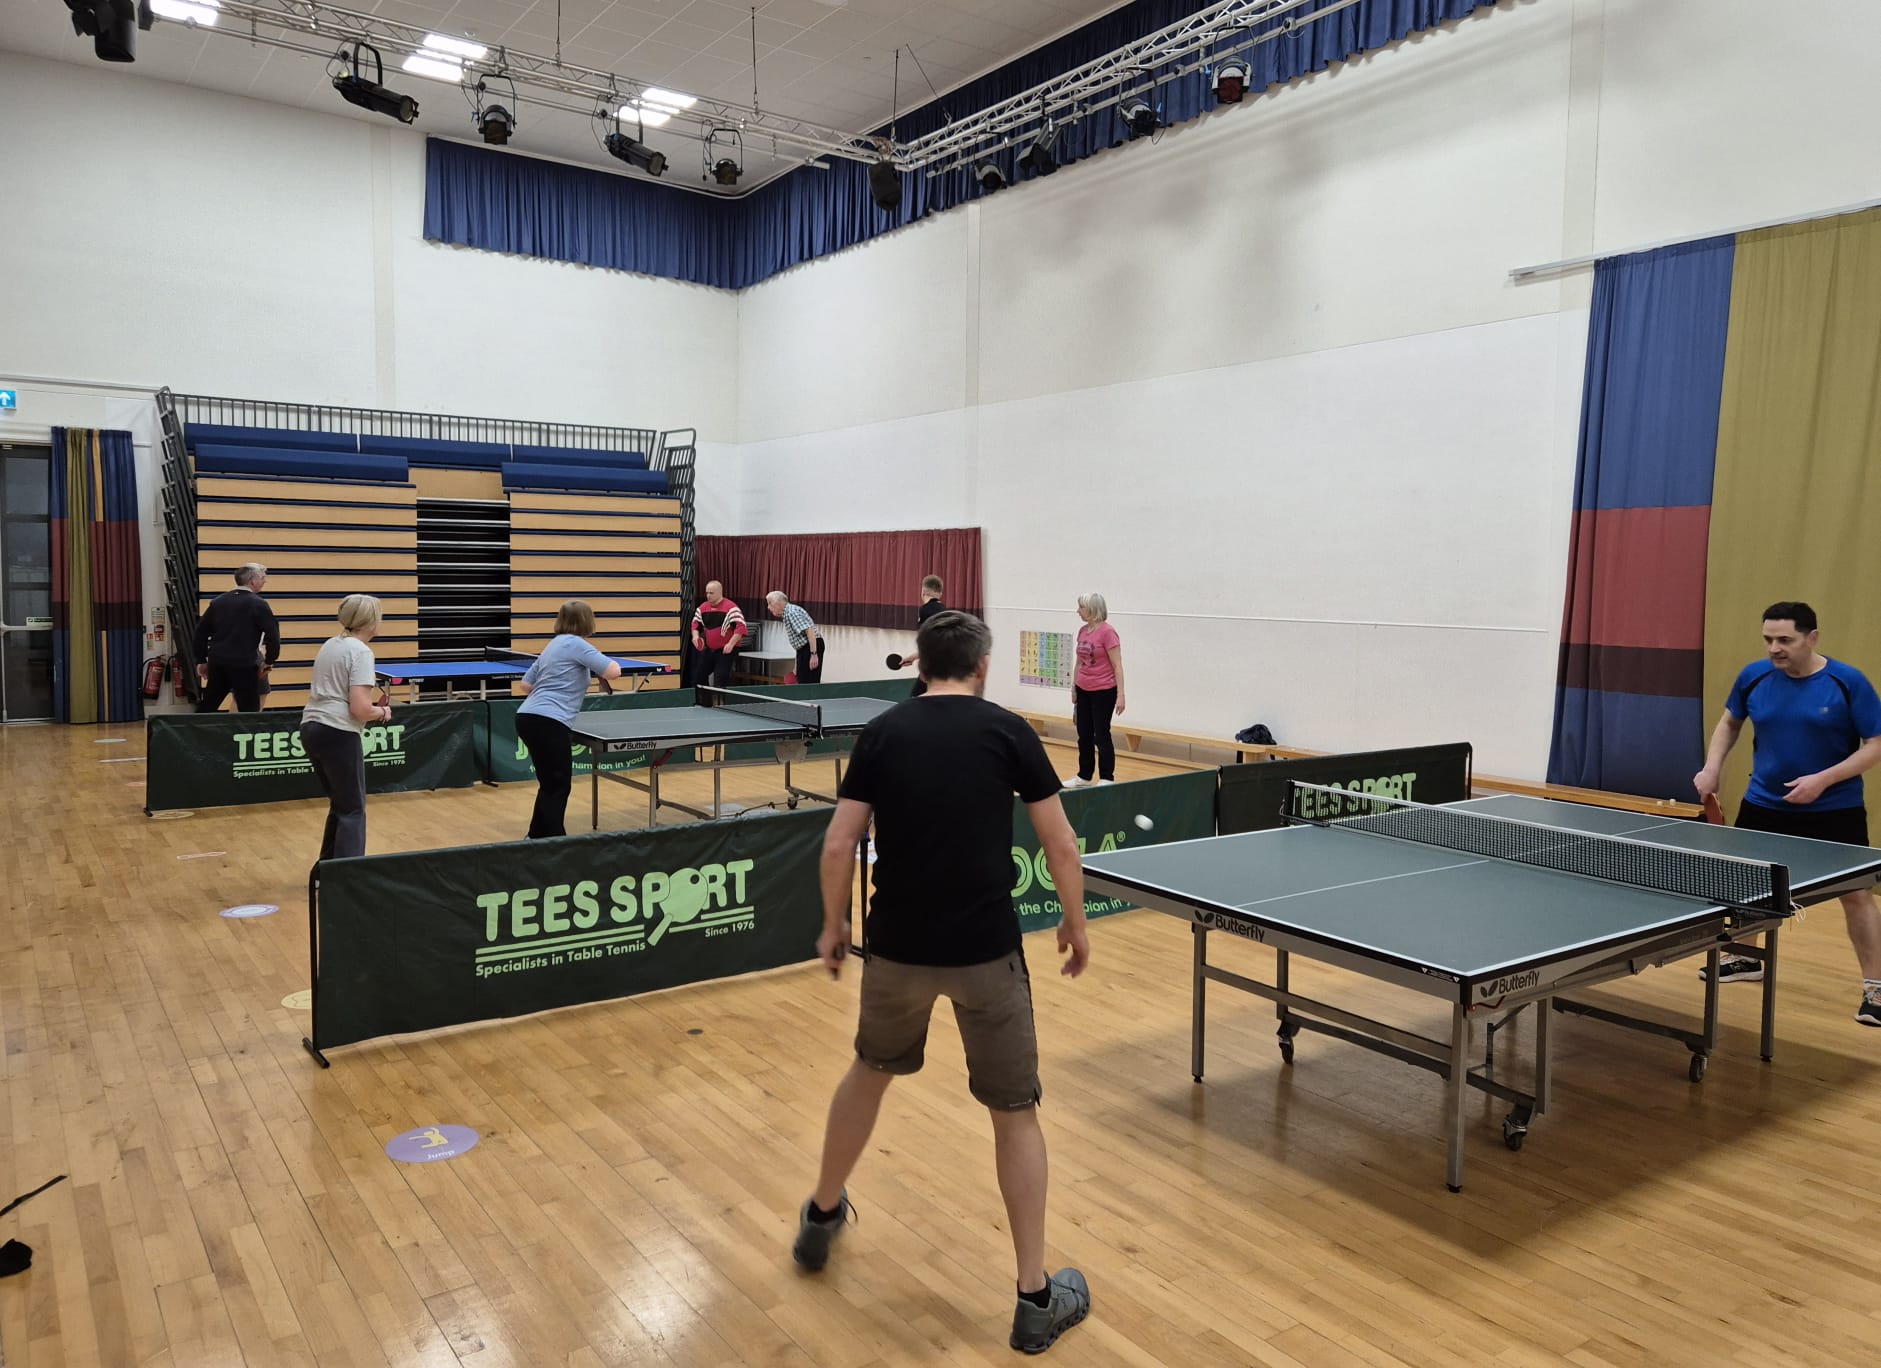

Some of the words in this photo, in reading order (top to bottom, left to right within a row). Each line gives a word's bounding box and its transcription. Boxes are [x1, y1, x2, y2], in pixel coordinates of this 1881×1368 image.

[626, 741, 657, 750] Butterfly
[572, 761, 613, 770] hamion
[615, 761, 624, 769] in
[626, 754, 646, 767] you!
[233, 769, 275, 779] Specialists
[476, 880, 599, 942] TEES
[610, 859, 754, 926] SPORT
[1019, 902, 1041, 916] the
[1044, 900, 1108, 913] Chpion
[1110, 898, 1123, 910] in
[705, 926, 729, 938] Since
[732, 920, 755, 933] 1976
[1215, 914, 1265, 942] Butterfly
[475, 957, 548, 979] Specialists
[551, 953, 564, 966] in
[567, 946, 603, 962] Table
[606, 940, 646, 956] Tennis
[1499, 971, 1540, 994] Butterfly
